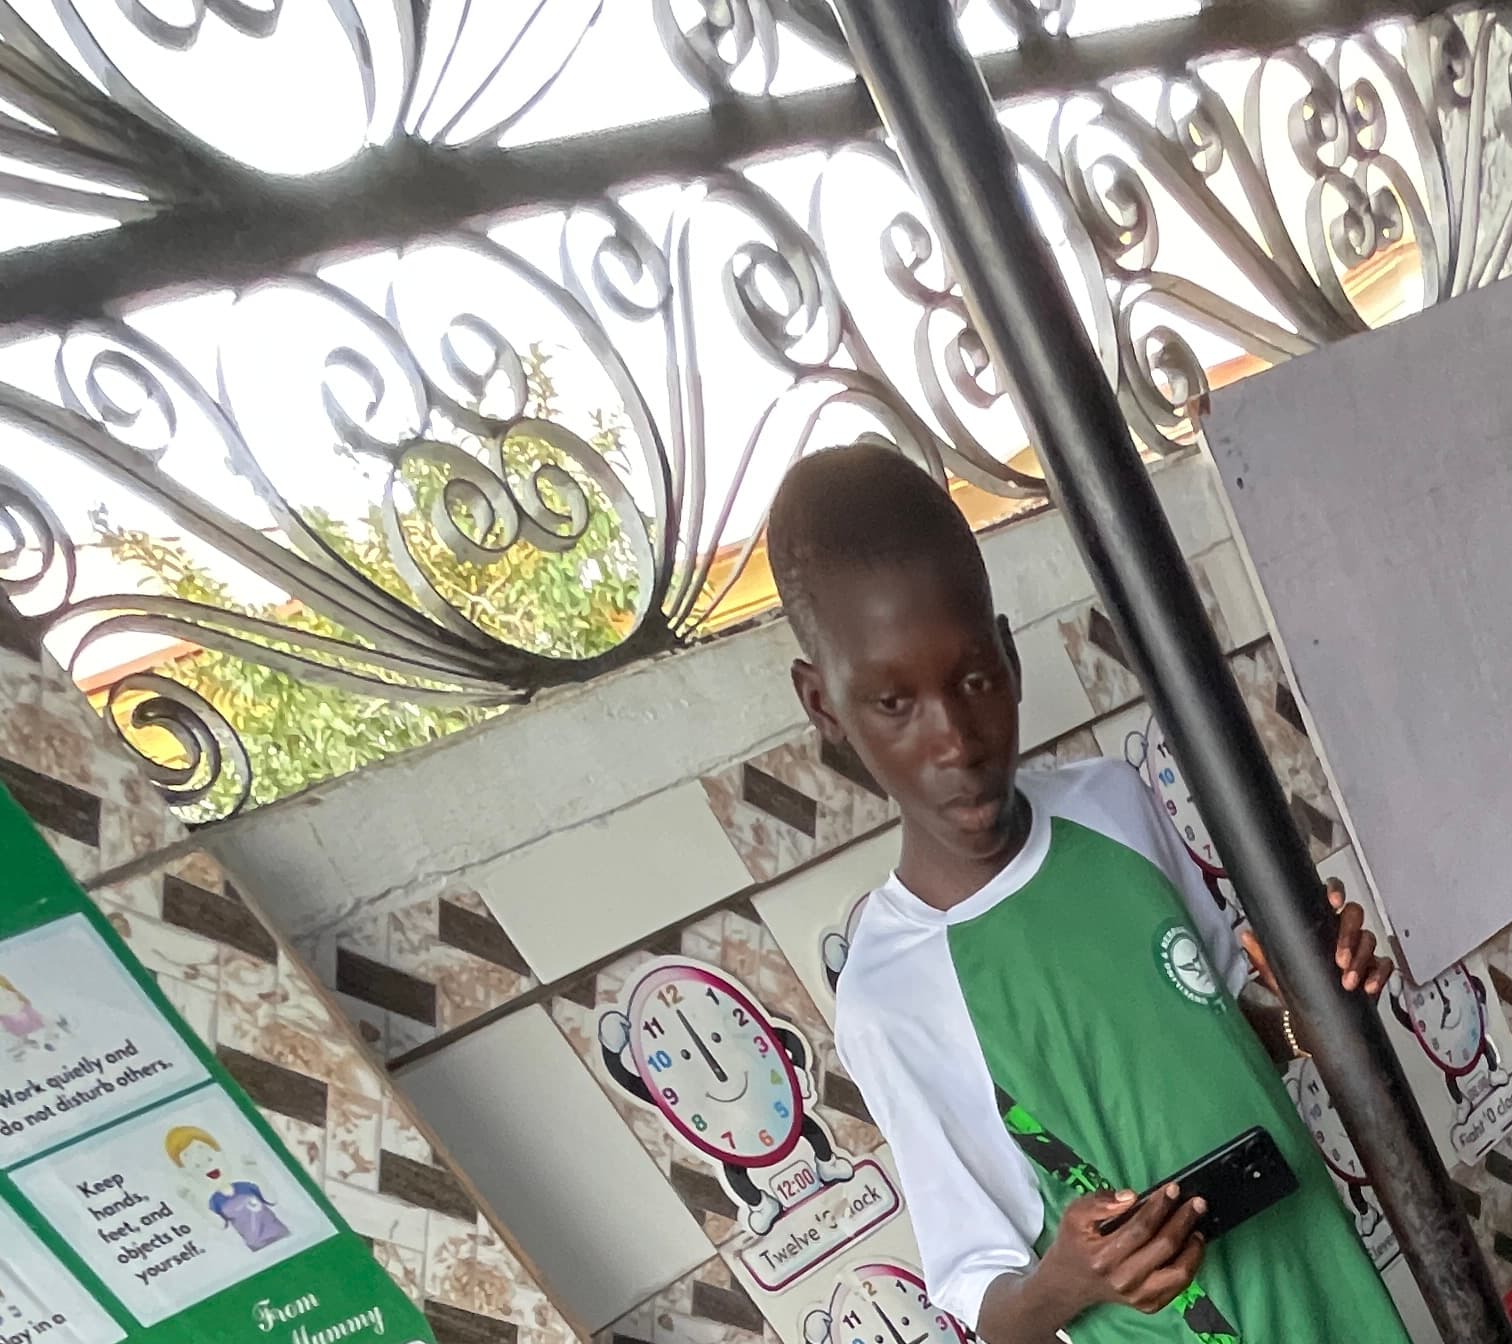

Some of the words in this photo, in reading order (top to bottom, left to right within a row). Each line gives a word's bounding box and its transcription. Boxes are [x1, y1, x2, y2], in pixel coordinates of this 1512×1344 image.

[657, 984, 684, 1008] 12
[732, 1008, 749, 1026] 2
[642, 1018, 665, 1039] 11
[753, 1035, 769, 1055] 3
[46, 1056, 104, 1091] quietly
[105, 1038, 139, 1064] and
[647, 1050, 673, 1072] 10
[662, 1087, 679, 1105] 9
[0, 1118, 24, 1136] do
[24, 1105, 57, 1126] not
[56, 1079, 116, 1112] disturb
[774, 1102, 789, 1119] 5
[691, 1114, 708, 1132] 8
[721, 1131, 736, 1149] 7
[758, 1129, 775, 1147] 6
[76, 1174, 125, 1199] Keep
[776, 1168, 816, 1201] 12:00
[88, 1191, 150, 1222] hands,
[98, 1221, 141, 1244] feet,
[140, 1201, 174, 1227] and
[116, 1232, 172, 1265] objects
[171, 1223, 192, 1238] to
[759, 1228, 820, 1271] Twelve
[135, 1240, 206, 1286] yourself.
[28, 1318, 52, 1334] in
[52, 1313, 67, 1326] a
[252, 1293, 320, 1332] From
[842, 1310, 863, 1329] 11
[935, 1315, 948, 1331] 3
